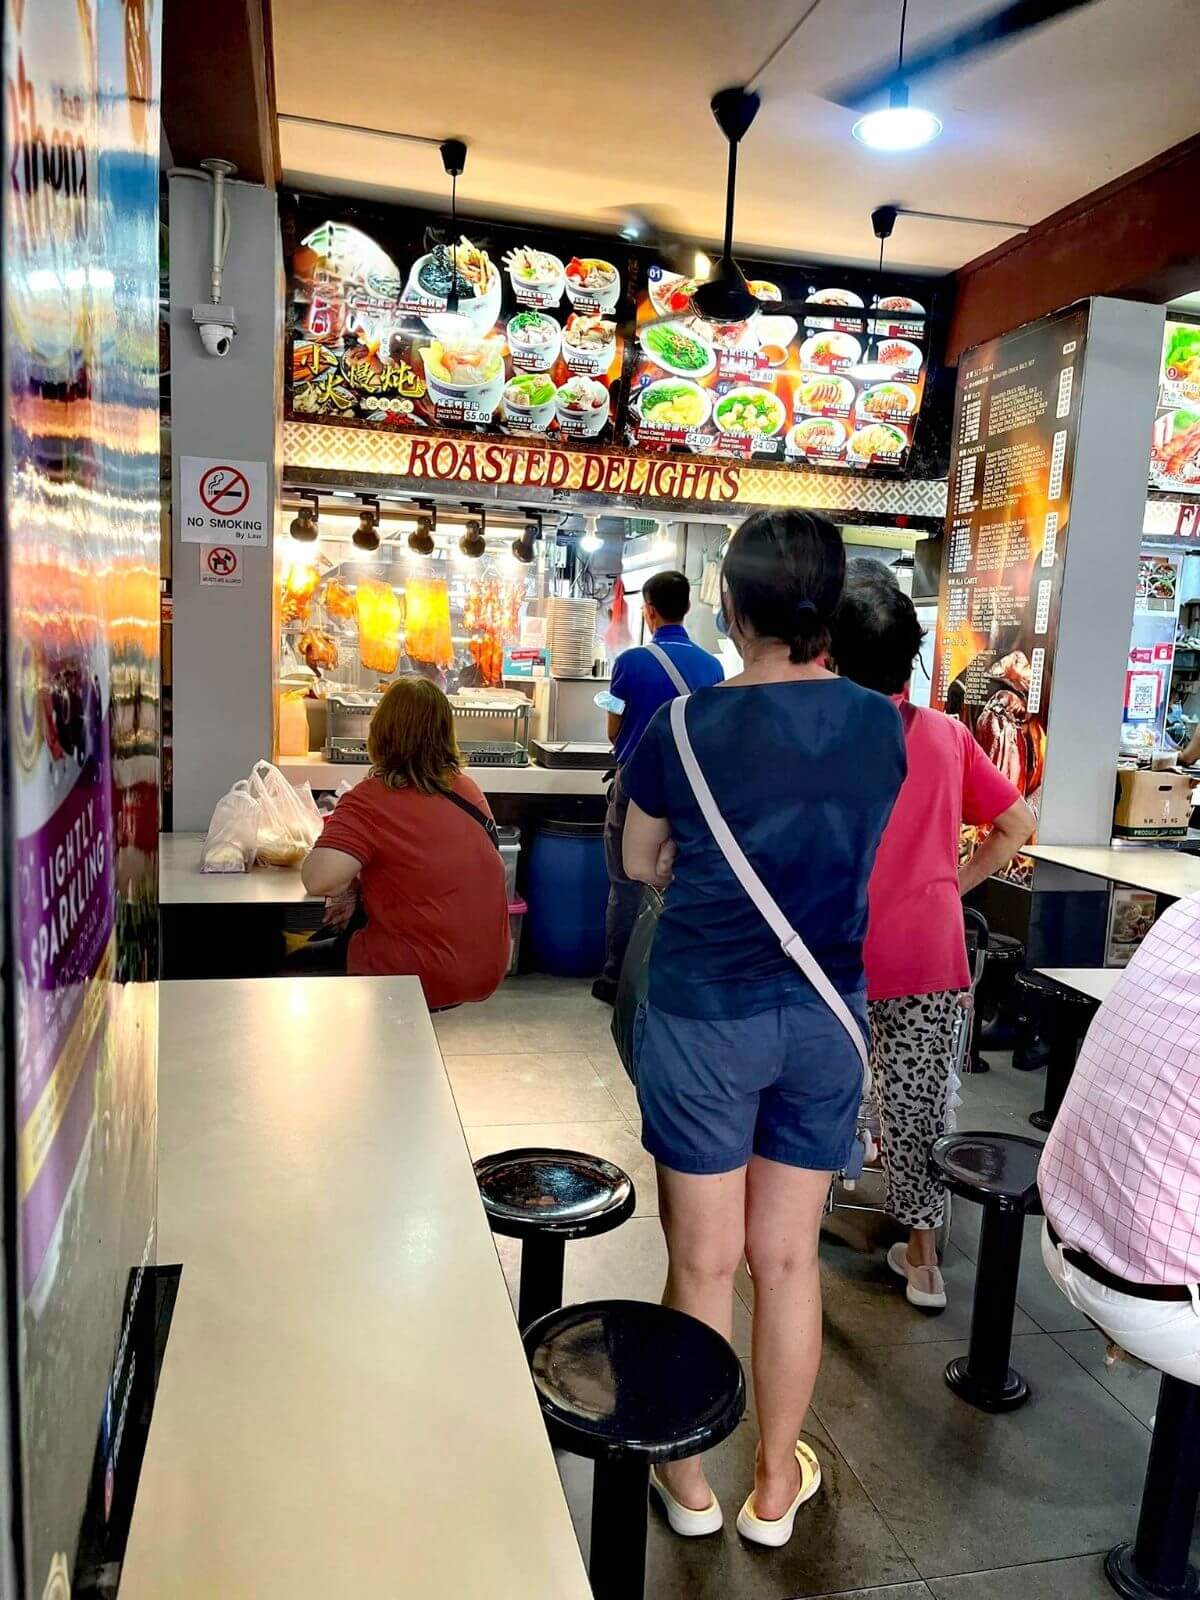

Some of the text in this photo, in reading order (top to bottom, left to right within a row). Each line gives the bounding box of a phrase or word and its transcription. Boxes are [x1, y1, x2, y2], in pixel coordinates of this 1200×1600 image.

[649, 268, 660, 279] 01
[642, 376, 650, 384] 17
[465, 412, 490, 422] $5.00
[686, 434, 711, 445] $4.00
[752, 440, 776, 450] $4.00
[967, 444, 986, 456] NOODLE
[408, 439, 741, 502] ROASTED DELIGHTS
[187, 517, 262, 531] NO SMOKING
[961, 518, 972, 526] SOUP
[236, 532, 262, 540] By Law
[41, 799, 94, 911] LIGHTLY
[30, 831, 105, 991] SPARKLING
